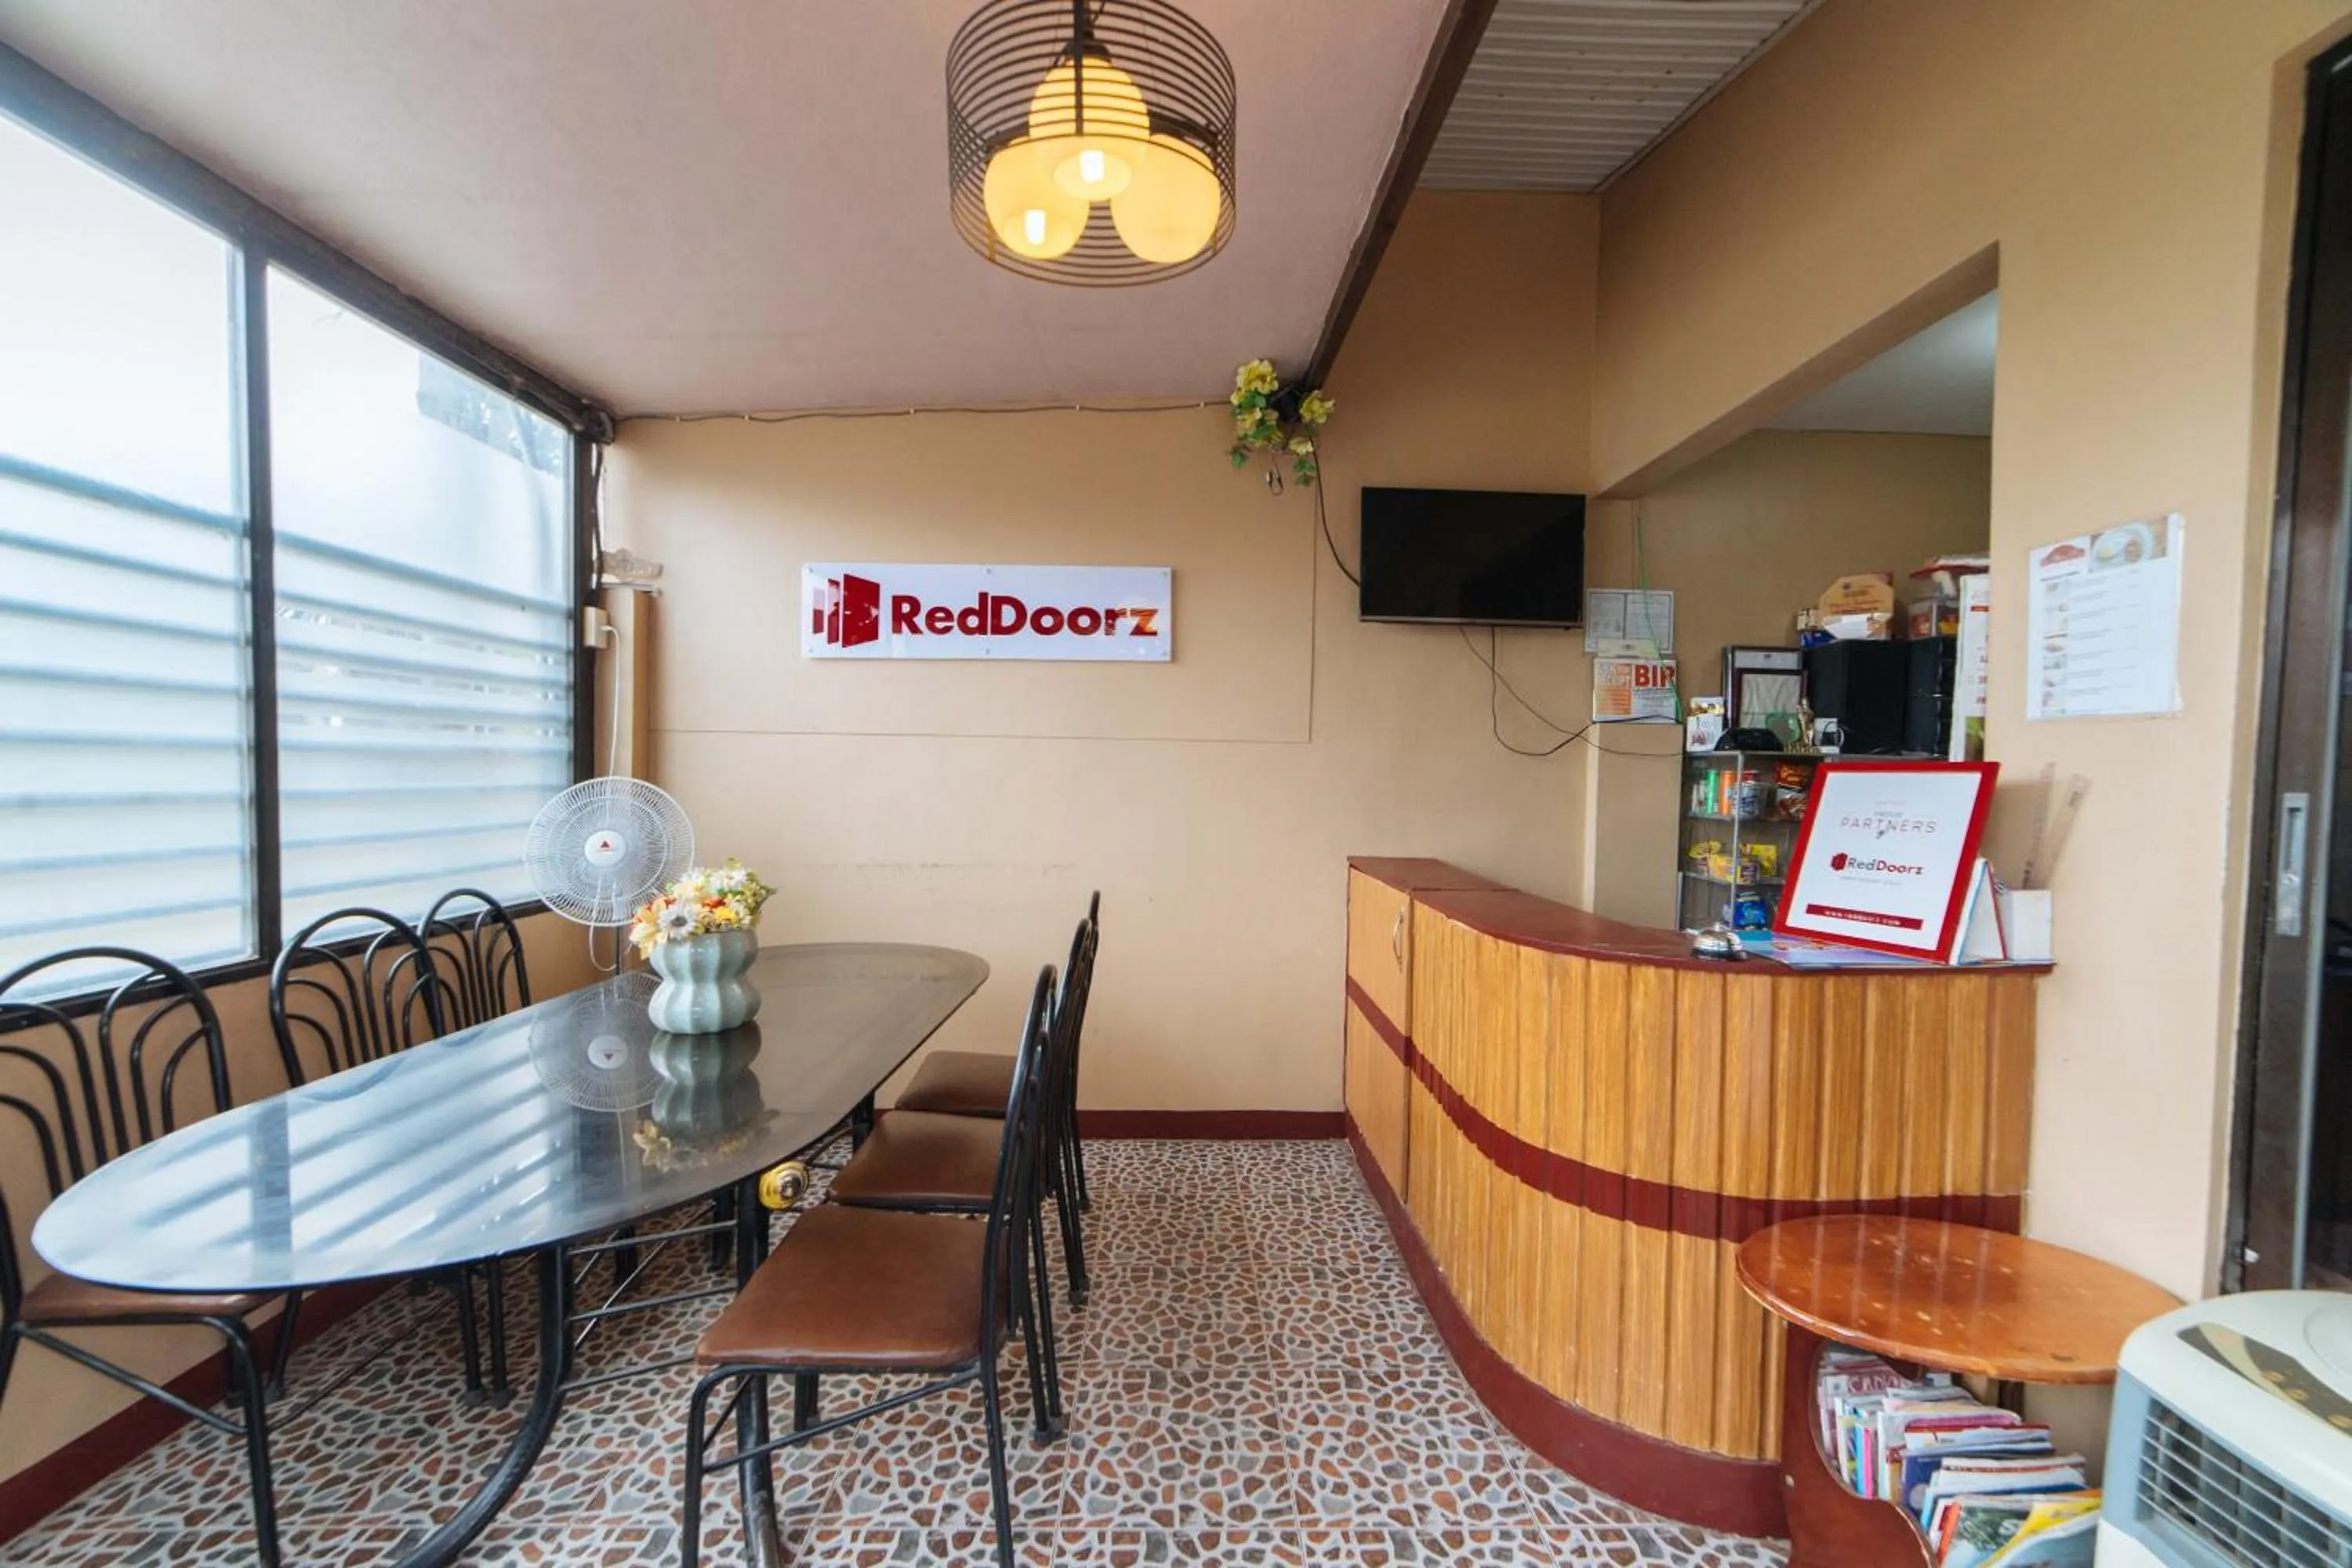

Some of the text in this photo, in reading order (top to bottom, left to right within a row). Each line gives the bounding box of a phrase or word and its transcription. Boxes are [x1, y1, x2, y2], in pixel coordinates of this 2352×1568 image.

[891, 592, 1158, 636] RedDoorz
[1840, 817, 1937, 833] PARTNERS
[1848, 857, 1924, 875] RedDoorz
